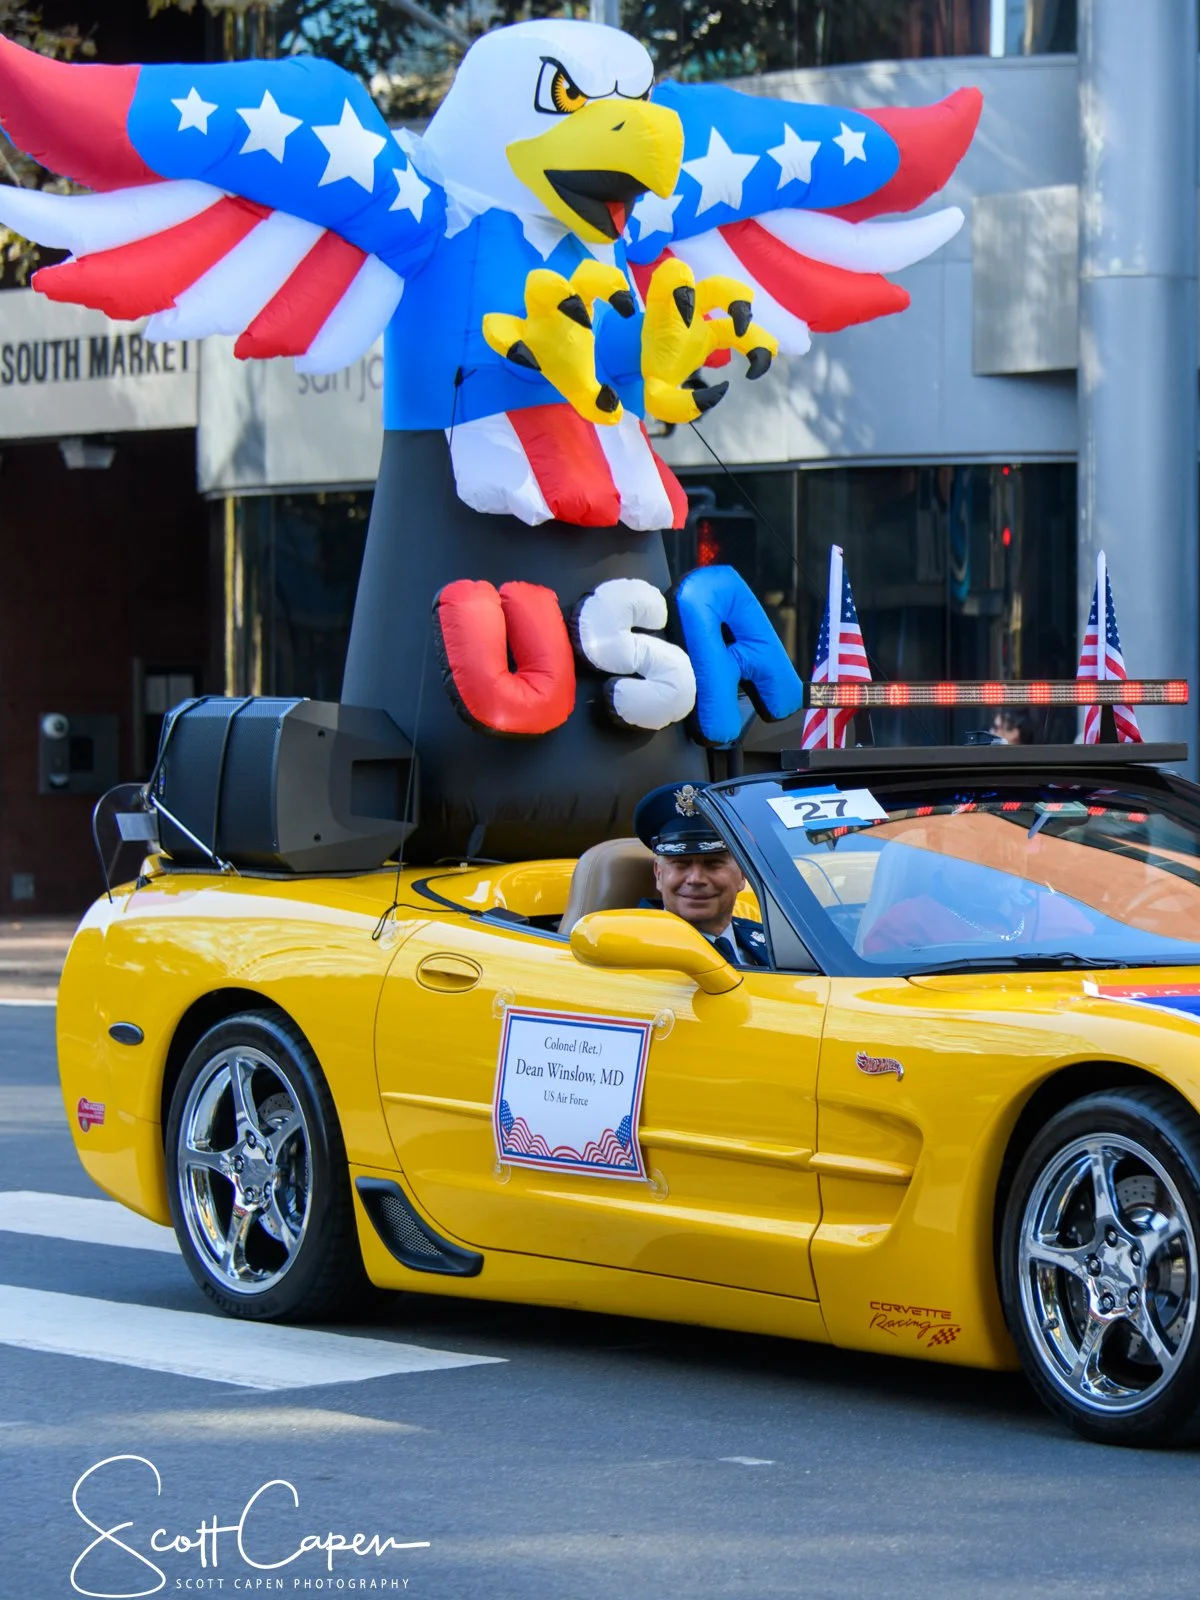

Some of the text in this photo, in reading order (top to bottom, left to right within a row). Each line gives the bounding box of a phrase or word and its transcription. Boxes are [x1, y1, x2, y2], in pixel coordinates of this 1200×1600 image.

[1, 335, 189, 386] SOUTH MARKET
[433, 565, 802, 750] USA
[794, 799, 848, 821] 27
[544, 1036, 603, 1056] Colonel (Ret.)
[515, 1058, 624, 1087] Dean Winslow, MD
[543, 1090, 589, 1106] US Air Force
[870, 1301, 952, 1320] CORVETTE
[869, 1312, 960, 1340] Racing
